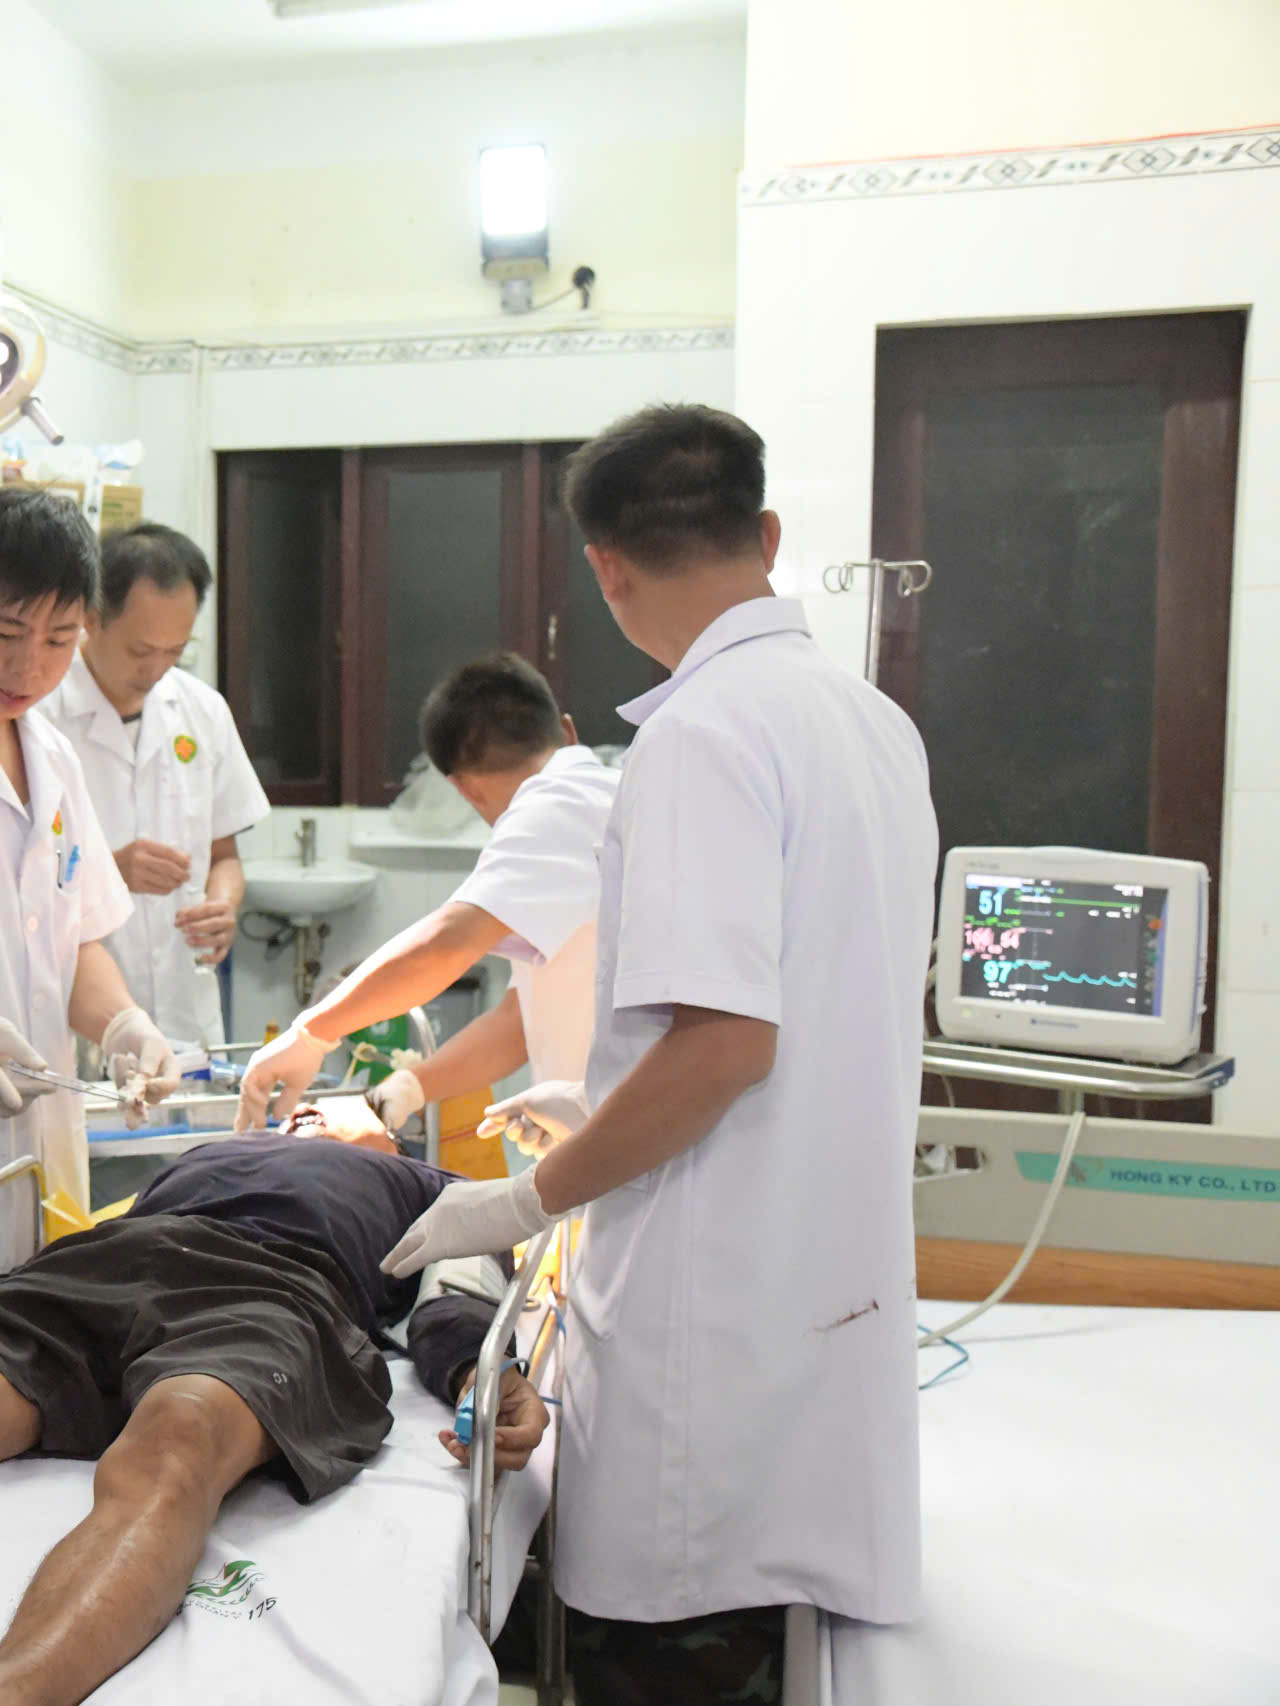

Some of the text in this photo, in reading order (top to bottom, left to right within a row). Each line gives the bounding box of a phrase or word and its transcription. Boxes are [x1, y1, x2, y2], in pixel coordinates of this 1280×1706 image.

[978, 889, 1003, 916] 51
[983, 960, 1013, 984] 97
[1168, 1174, 1192, 1187] KY
[1240, 1179, 1277, 1193] LTD
[248, 1597, 278, 1620] 175
